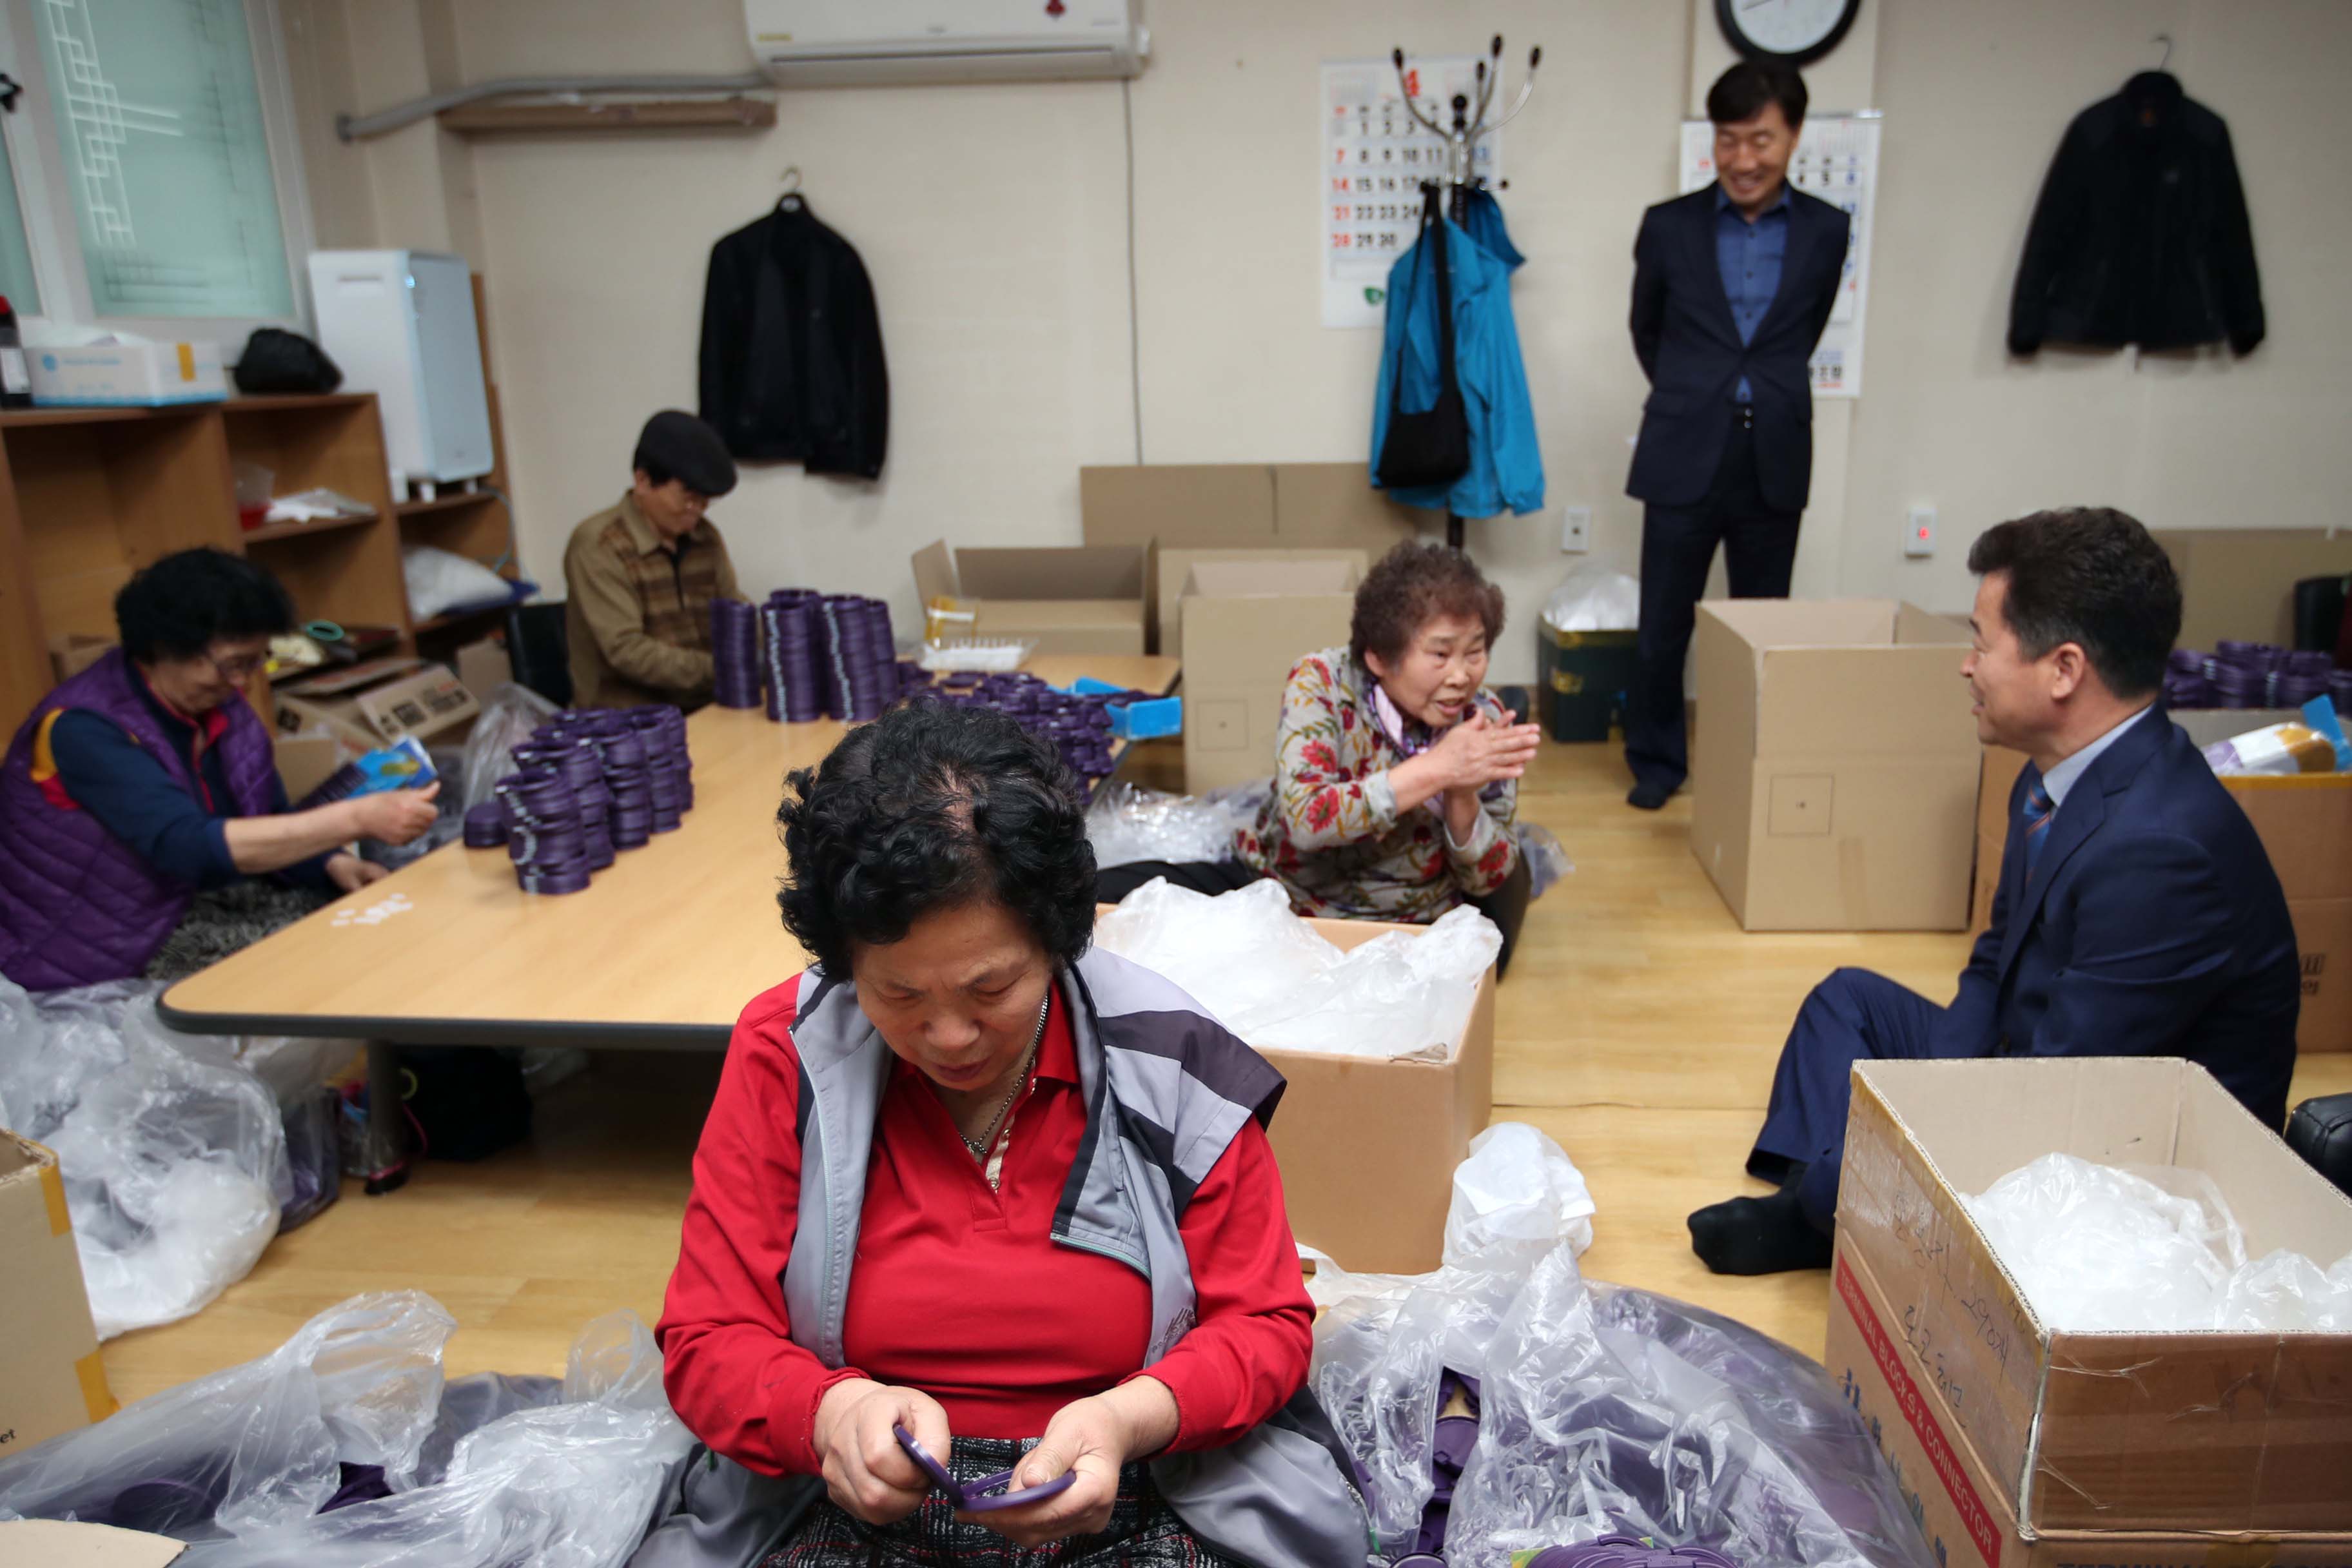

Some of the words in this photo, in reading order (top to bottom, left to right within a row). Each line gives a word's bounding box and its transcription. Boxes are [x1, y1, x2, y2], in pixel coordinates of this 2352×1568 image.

[1336, 148, 1345, 164] 7
[1360, 149, 1369, 164] 8
[1384, 149, 1392, 163] 9
[1402, 148, 1419, 164] 10
[1426, 148, 1442, 164] 11
[1332, 177, 1349, 191] 14
[1356, 177, 1373, 191] 15
[1379, 177, 1395, 191] 16
[1402, 175, 1419, 191] 17
[1333, 204, 1351, 220] 21
[1356, 204, 1373, 220] 22
[1379, 204, 1396, 220] 23
[1402, 204, 1420, 220] 24
[1332, 233, 1351, 248] 28
[1356, 233, 1373, 248] 29
[1379, 233, 1396, 248] 30
[1841, 1268, 1877, 1348] TERMINAL
[1879, 1343, 1916, 1415] BLOCKS
[1926, 1426, 1992, 1554] CONNECTOR
